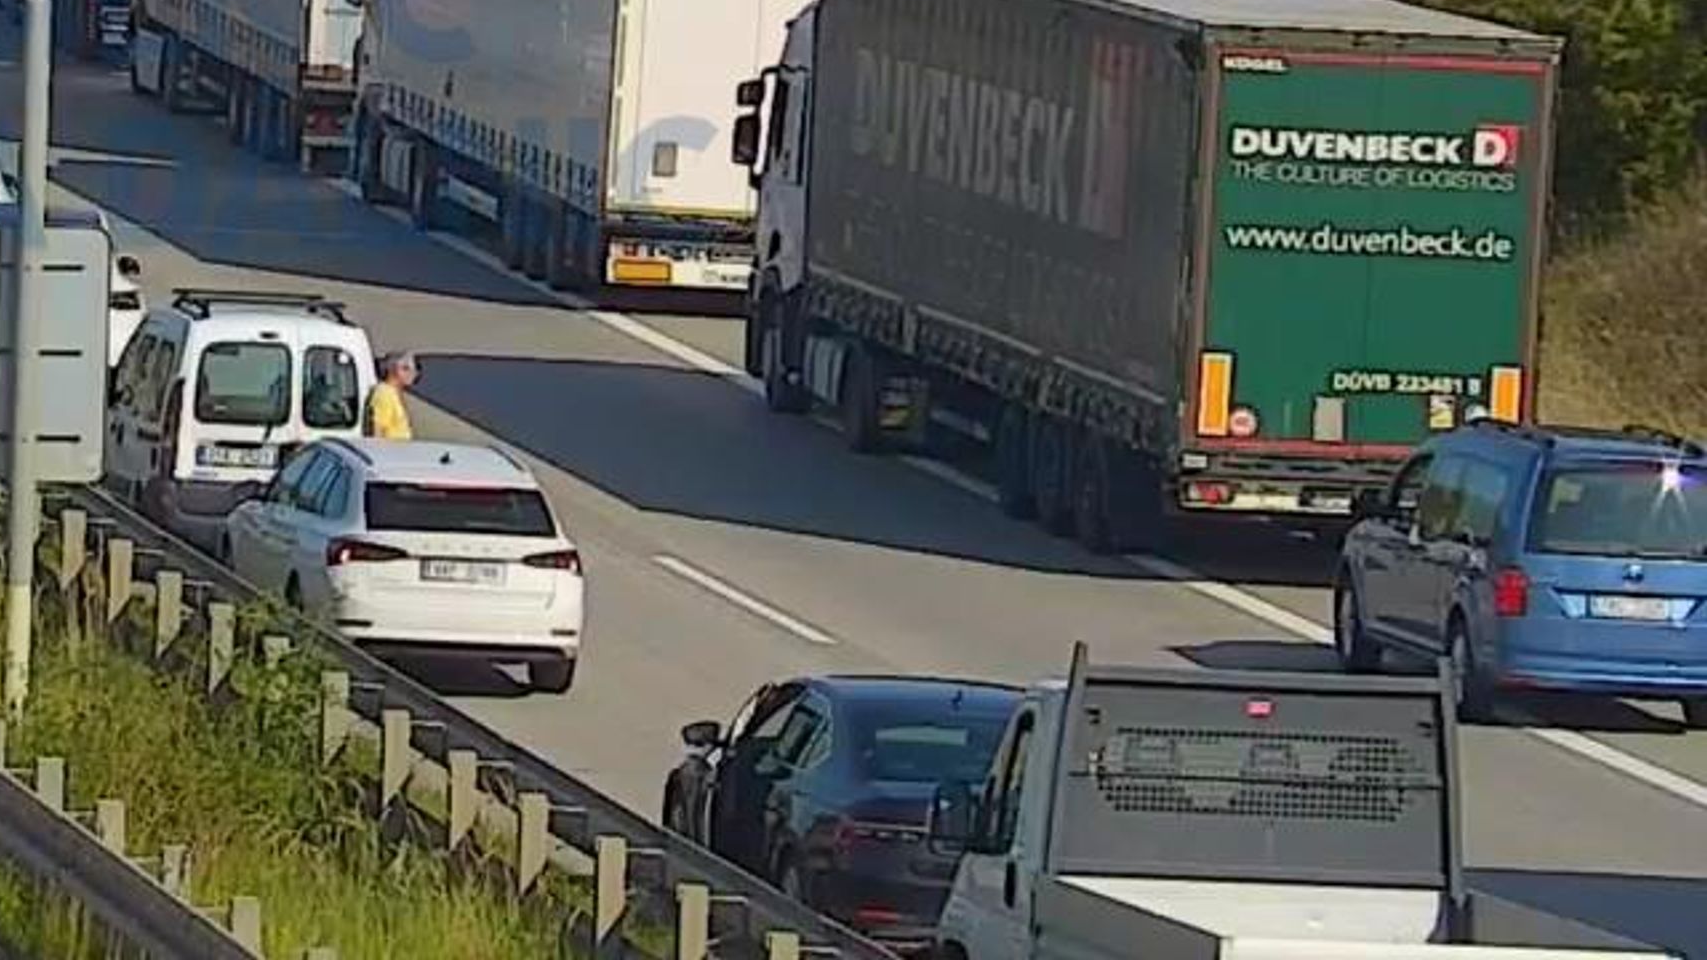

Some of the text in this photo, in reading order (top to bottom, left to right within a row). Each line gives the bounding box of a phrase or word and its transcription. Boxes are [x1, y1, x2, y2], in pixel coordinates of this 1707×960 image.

[853, 48, 1074, 226] DUVENBECK
[1232, 128, 1507, 167] DUVENBECK D
[1233, 161, 1515, 191] THE CULTURE OF LOGISTICS
[1226, 224, 1512, 259] www.duvenbeck.de
